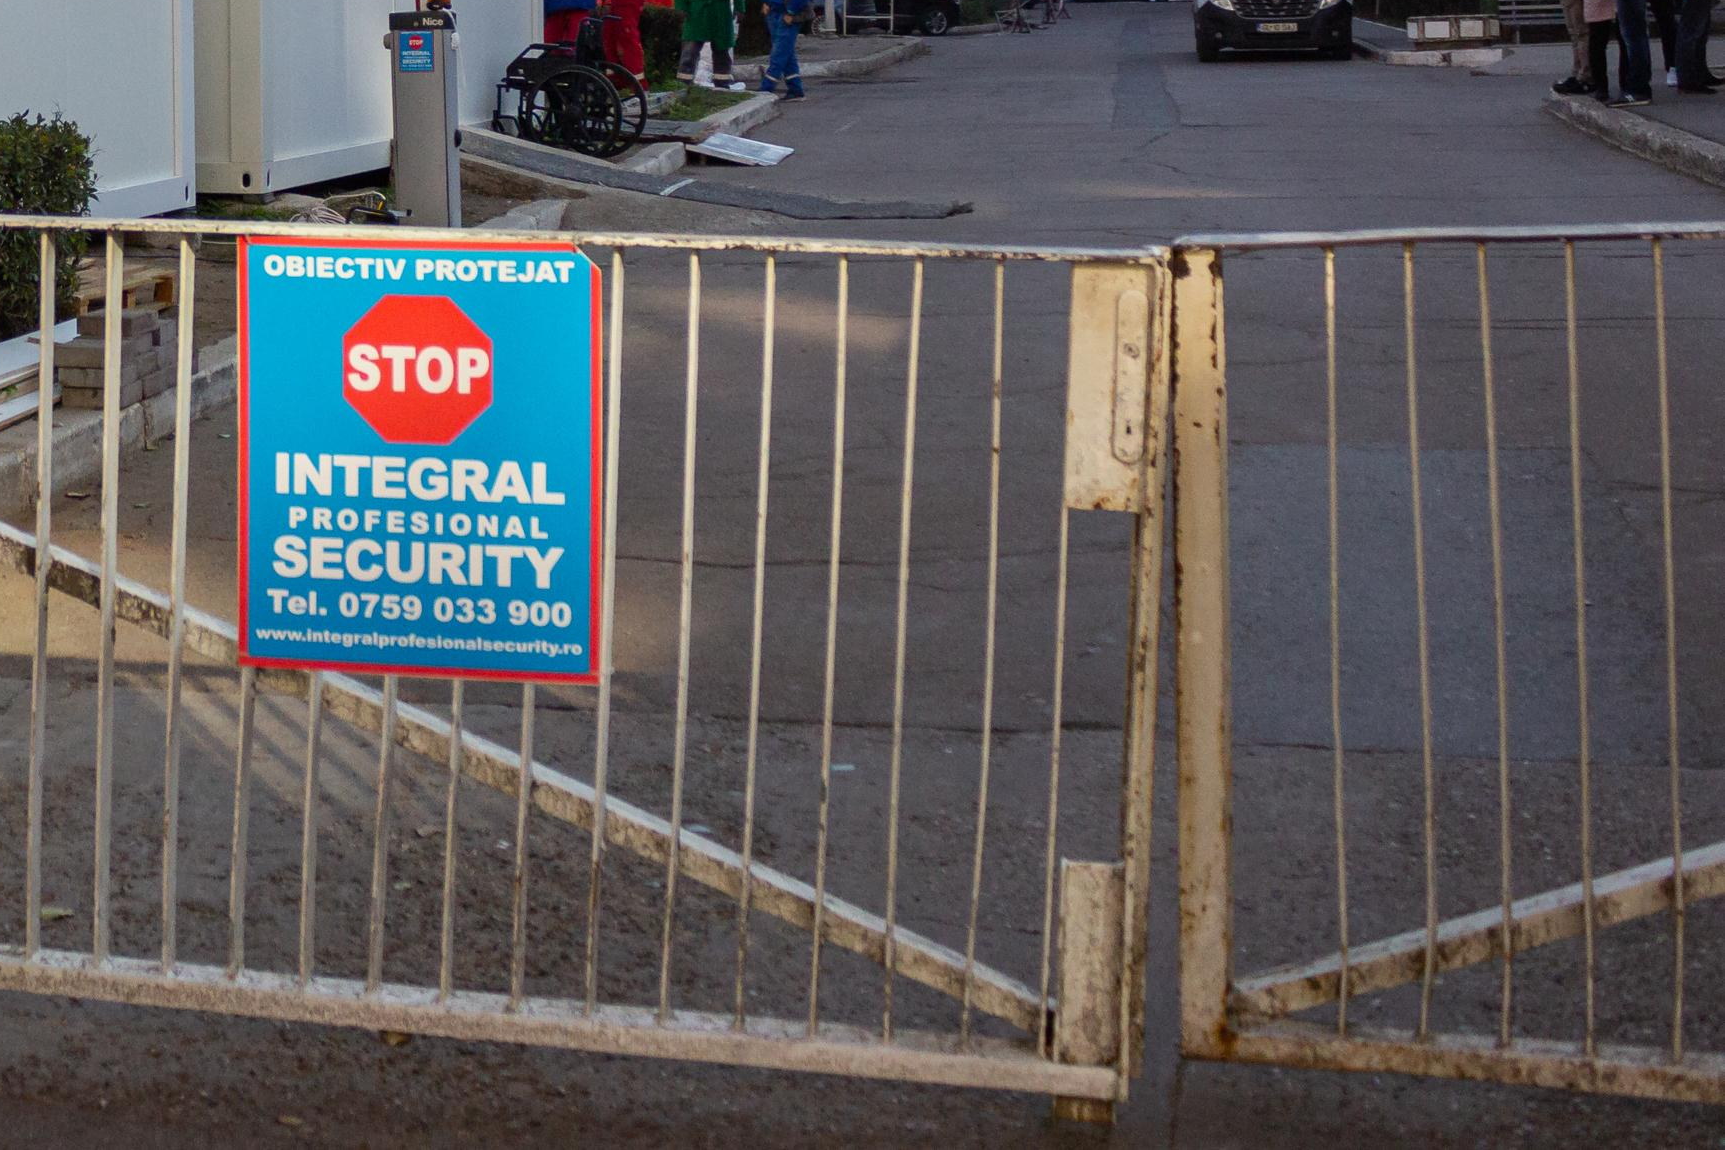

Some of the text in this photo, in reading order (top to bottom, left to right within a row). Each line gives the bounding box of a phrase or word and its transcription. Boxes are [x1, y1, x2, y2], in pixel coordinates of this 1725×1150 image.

[422, 17, 444, 26] Nice
[264, 255, 575, 284] OBIECTIV PROTEJAT
[348, 343, 490, 395] STOP
[275, 451, 566, 506] INTEGRAL
[288, 506, 549, 540] PROFESIONAL
[272, 535, 565, 589] SECURITY
[266, 588, 572, 628] Tel. 0759 033 900
[256, 628, 583, 657] www.integralprofesionalsecurity.ro
